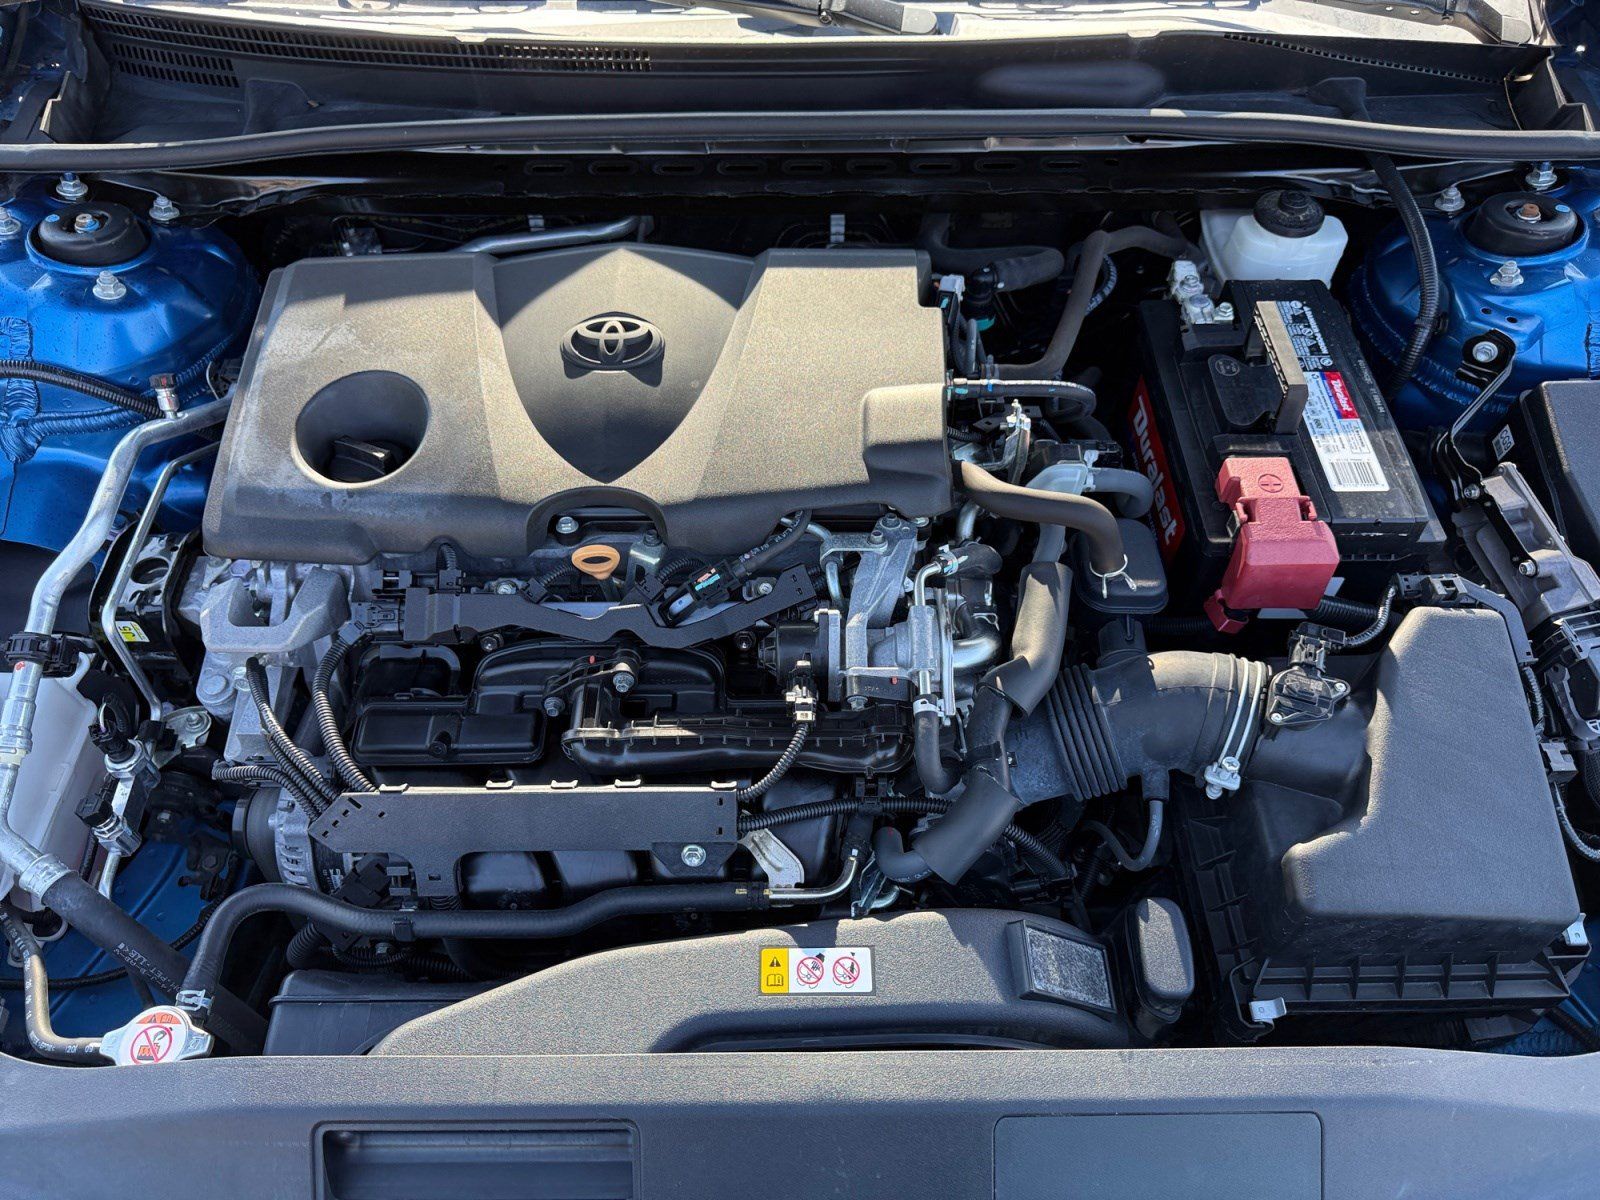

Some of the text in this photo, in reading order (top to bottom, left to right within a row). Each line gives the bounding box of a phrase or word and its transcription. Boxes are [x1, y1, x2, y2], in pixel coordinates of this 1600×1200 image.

[1315, 332, 1329, 354] POISON
[1330, 379, 1352, 411] Duralast
[1132, 395, 1177, 545] Duralast
